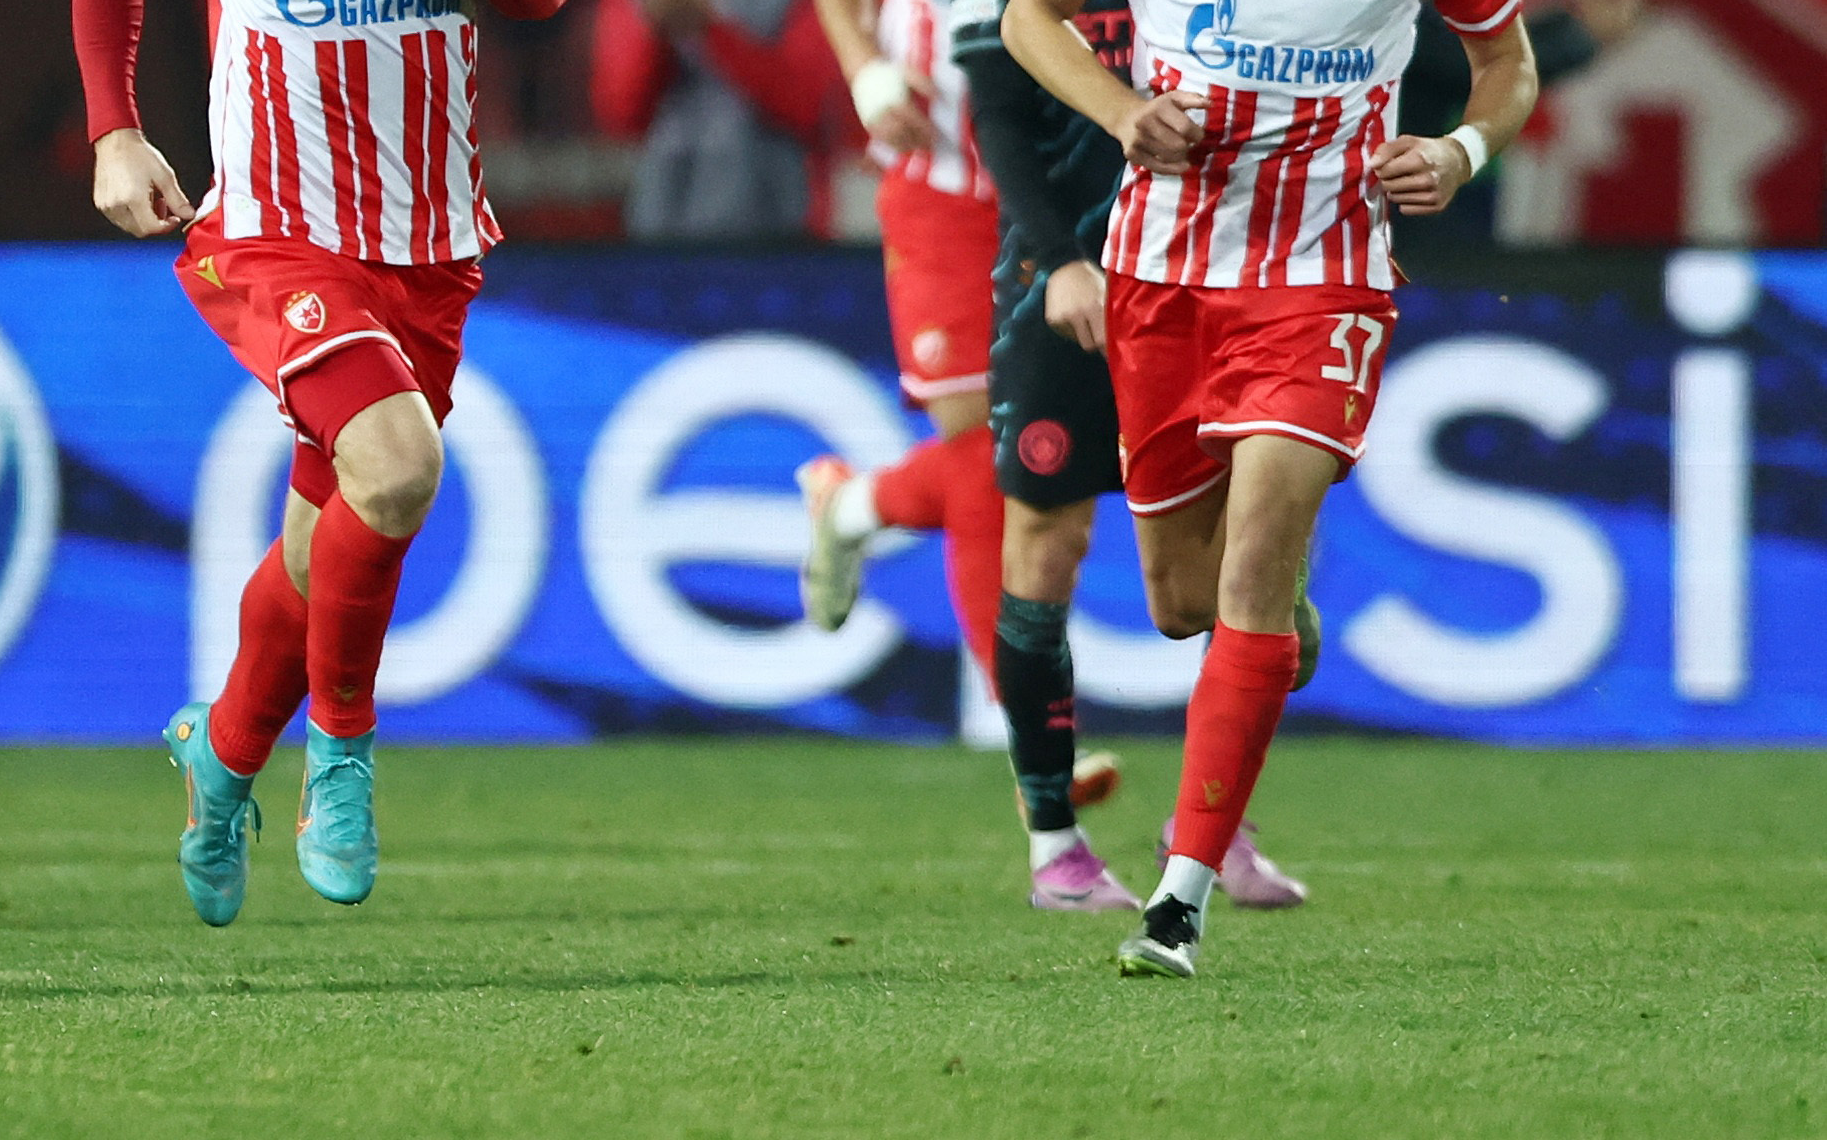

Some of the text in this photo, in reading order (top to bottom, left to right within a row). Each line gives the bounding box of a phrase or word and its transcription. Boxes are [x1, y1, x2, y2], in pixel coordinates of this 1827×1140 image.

[1237, 44, 1374, 84] GAZPROM
[1321, 312, 1385, 394] 37
[190, 248, 1756, 745] pesi
